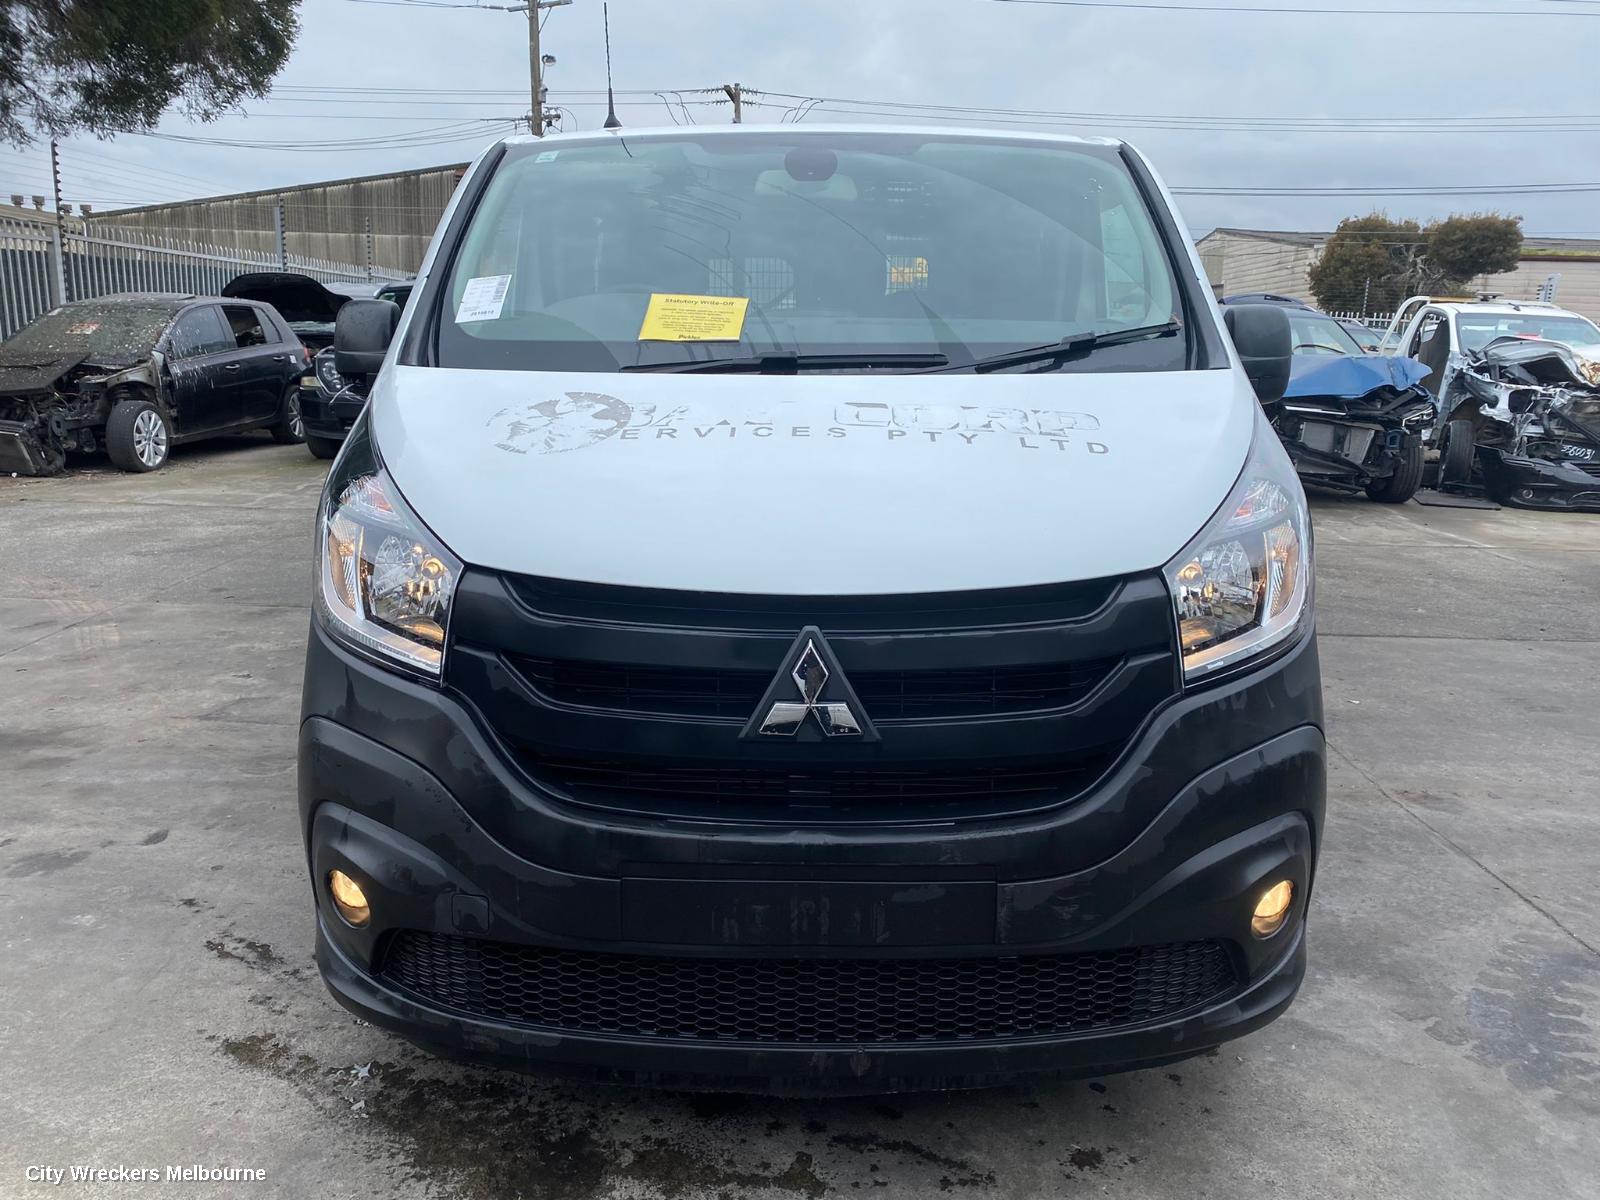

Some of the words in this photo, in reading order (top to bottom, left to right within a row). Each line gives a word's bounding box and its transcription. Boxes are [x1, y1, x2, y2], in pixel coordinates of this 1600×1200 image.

[664, 298, 698, 306] Statutory
[700, 299, 735, 307] Write-Off
[887, 429, 979, 446] PTY
[1018, 436, 1110, 455] LTD
